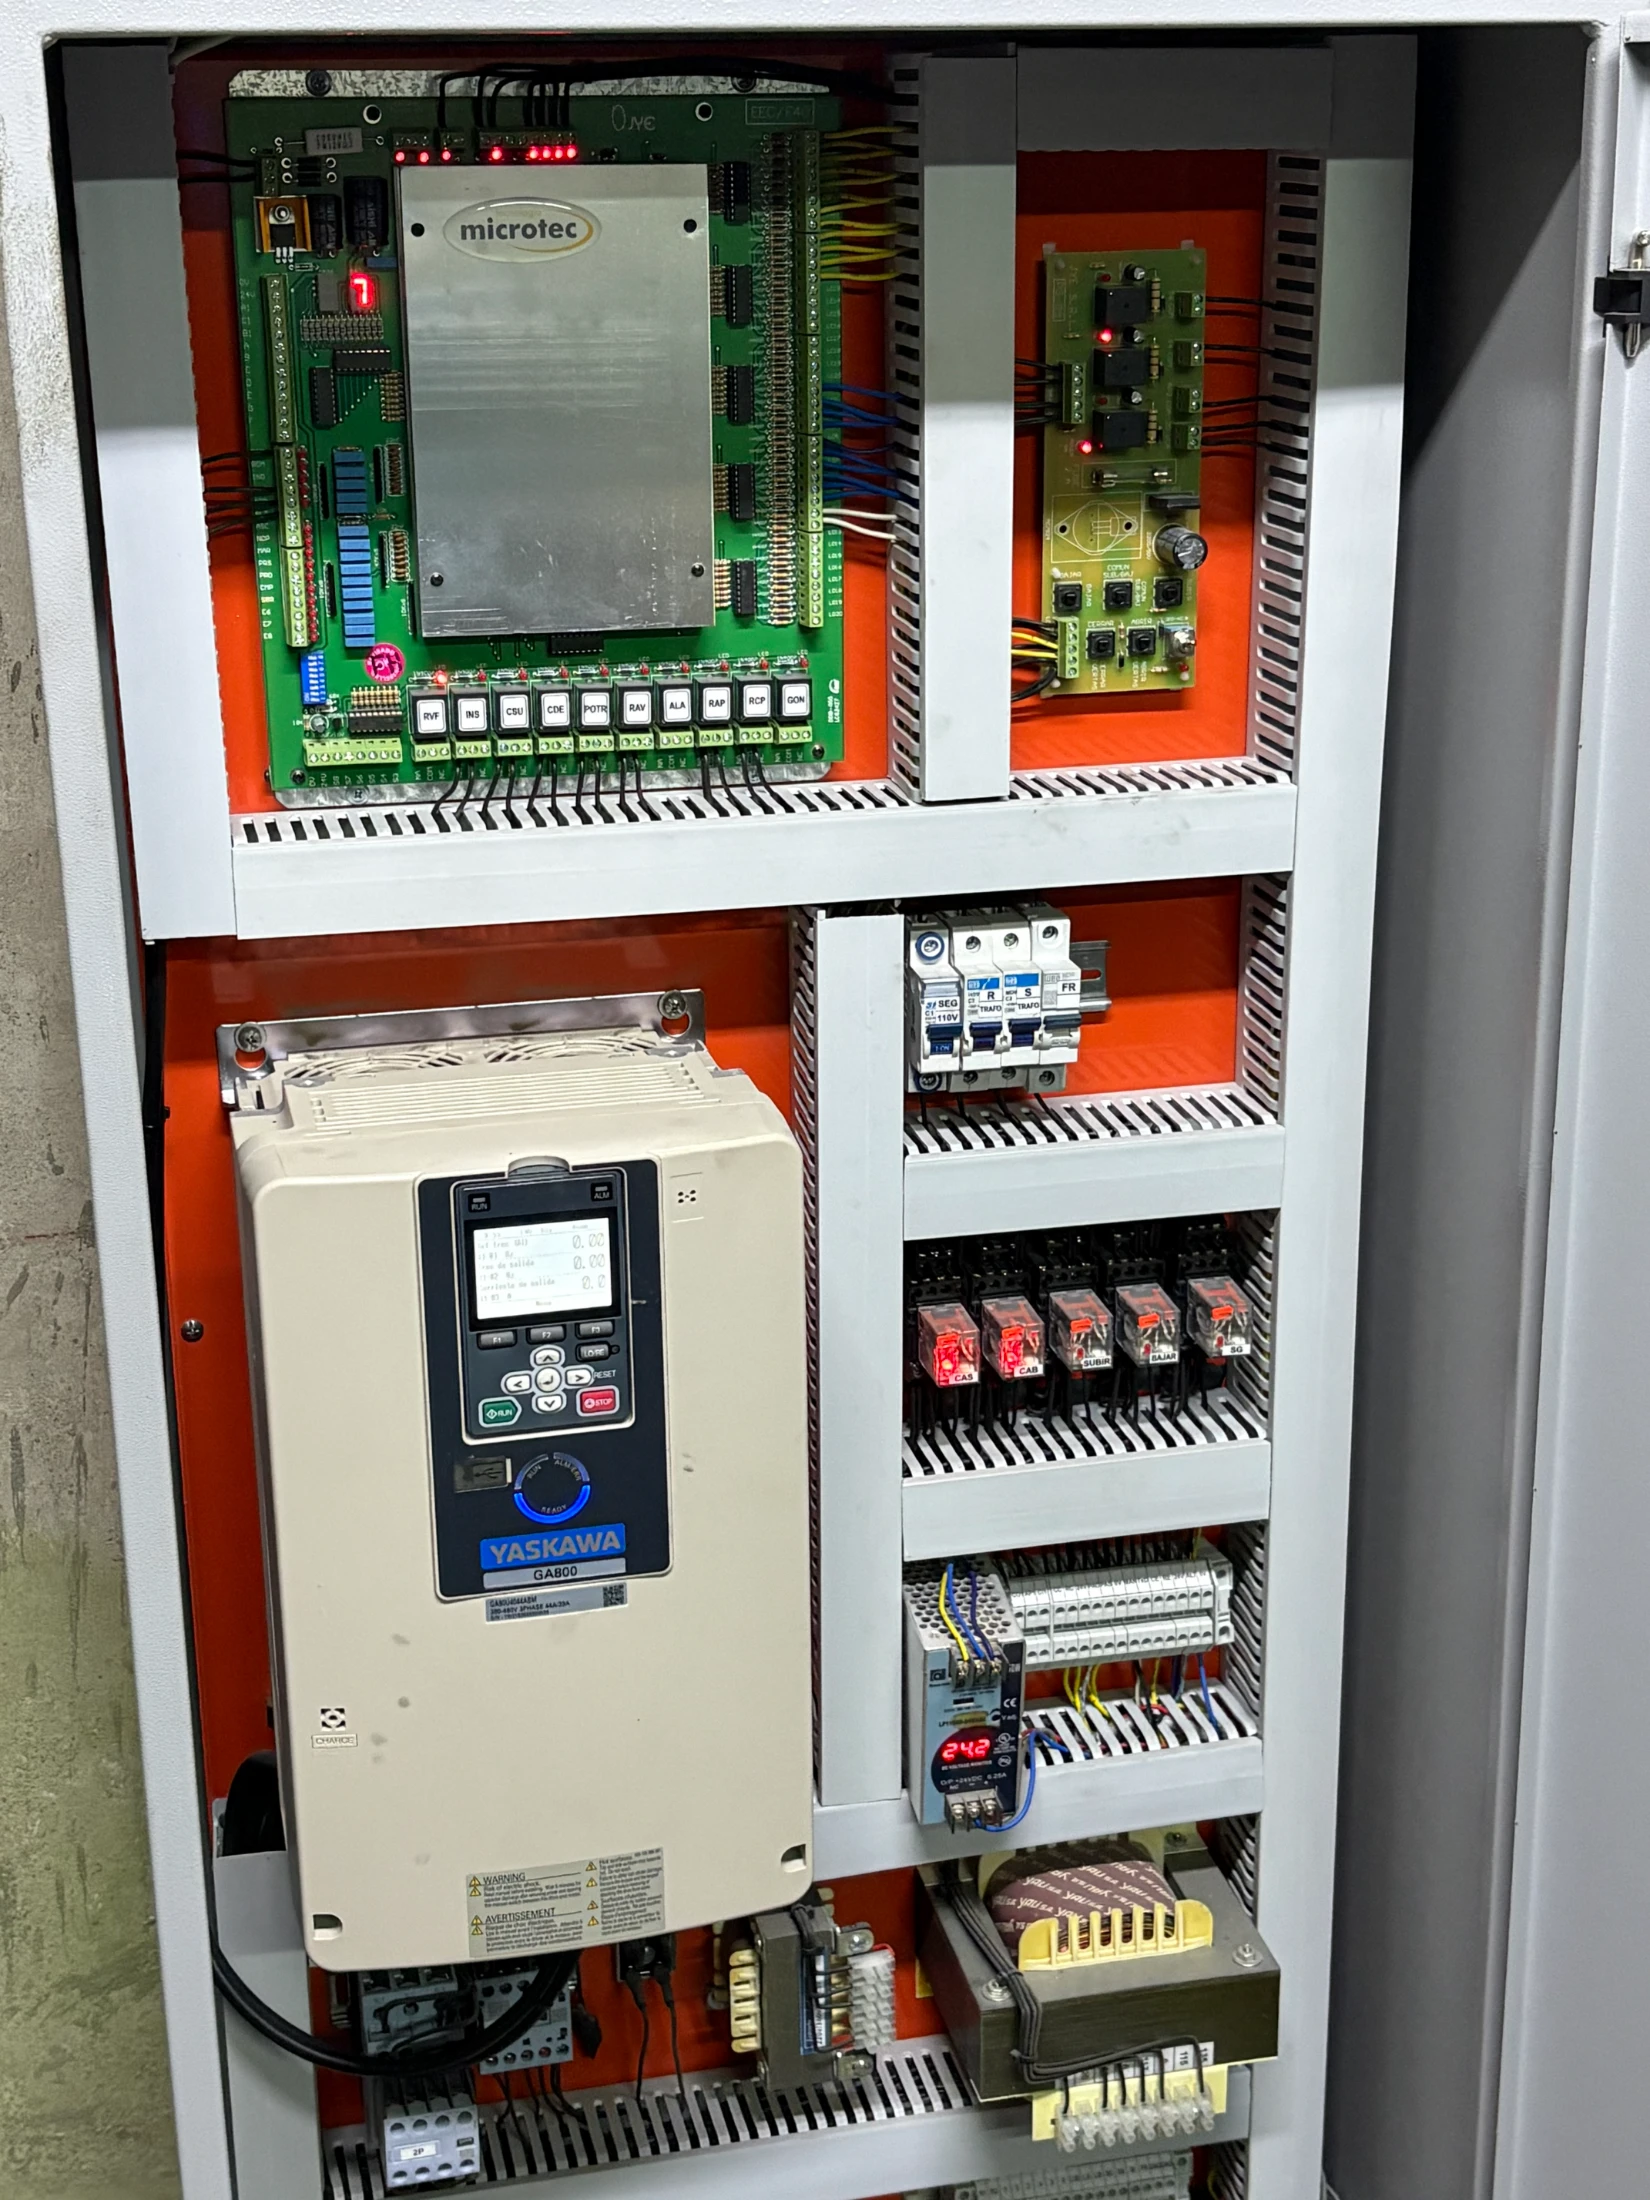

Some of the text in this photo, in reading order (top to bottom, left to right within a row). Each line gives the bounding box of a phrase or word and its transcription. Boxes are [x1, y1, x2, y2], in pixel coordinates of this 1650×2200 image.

[461, 217, 577, 241] microtec
[709, 699, 726, 708] RAP
[749, 696, 766, 705] RCP
[787, 695, 805, 705] GON
[547, 705, 565, 714] CDE
[584, 704, 608, 713] POTR
[629, 703, 646, 712] RAV
[669, 701, 686, 710] ALA
[423, 711, 440, 721] RVF
[466, 710, 480, 719] INS
[506, 707, 524, 716] CSU
[1062, 983, 1076, 991] FR
[987, 991, 995, 1000] R
[1025, 988, 1032, 997] S
[938, 1014, 958, 1022] 110V
[594, 1191, 610, 1199] ALM
[471, 1202, 488, 1210] RUN
[573, 1254, 605, 1269] 0.00
[542, 1331, 551, 1339] F2
[1151, 1352, 1177, 1362] BAJAR
[1083, 1357, 1111, 1367] SUBIR
[594, 1369, 617, 1379] RESET
[1019, 1366, 1039, 1374] CAB
[954, 1373, 974, 1382] CAS
[595, 1398, 612, 1407] STOP
[498, 1409, 513, 1418] RUN
[541, 1504, 567, 1514] READY
[490, 1530, 621, 1564] YASKAWA
[533, 1565, 578, 1581] GA800
[315, 1736, 355, 1745] CHARGE
[483, 1872, 526, 1885] WARNING
[485, 1907, 556, 1925] AVERTISSEMENT
[413, 2147, 425, 2156] 2P
